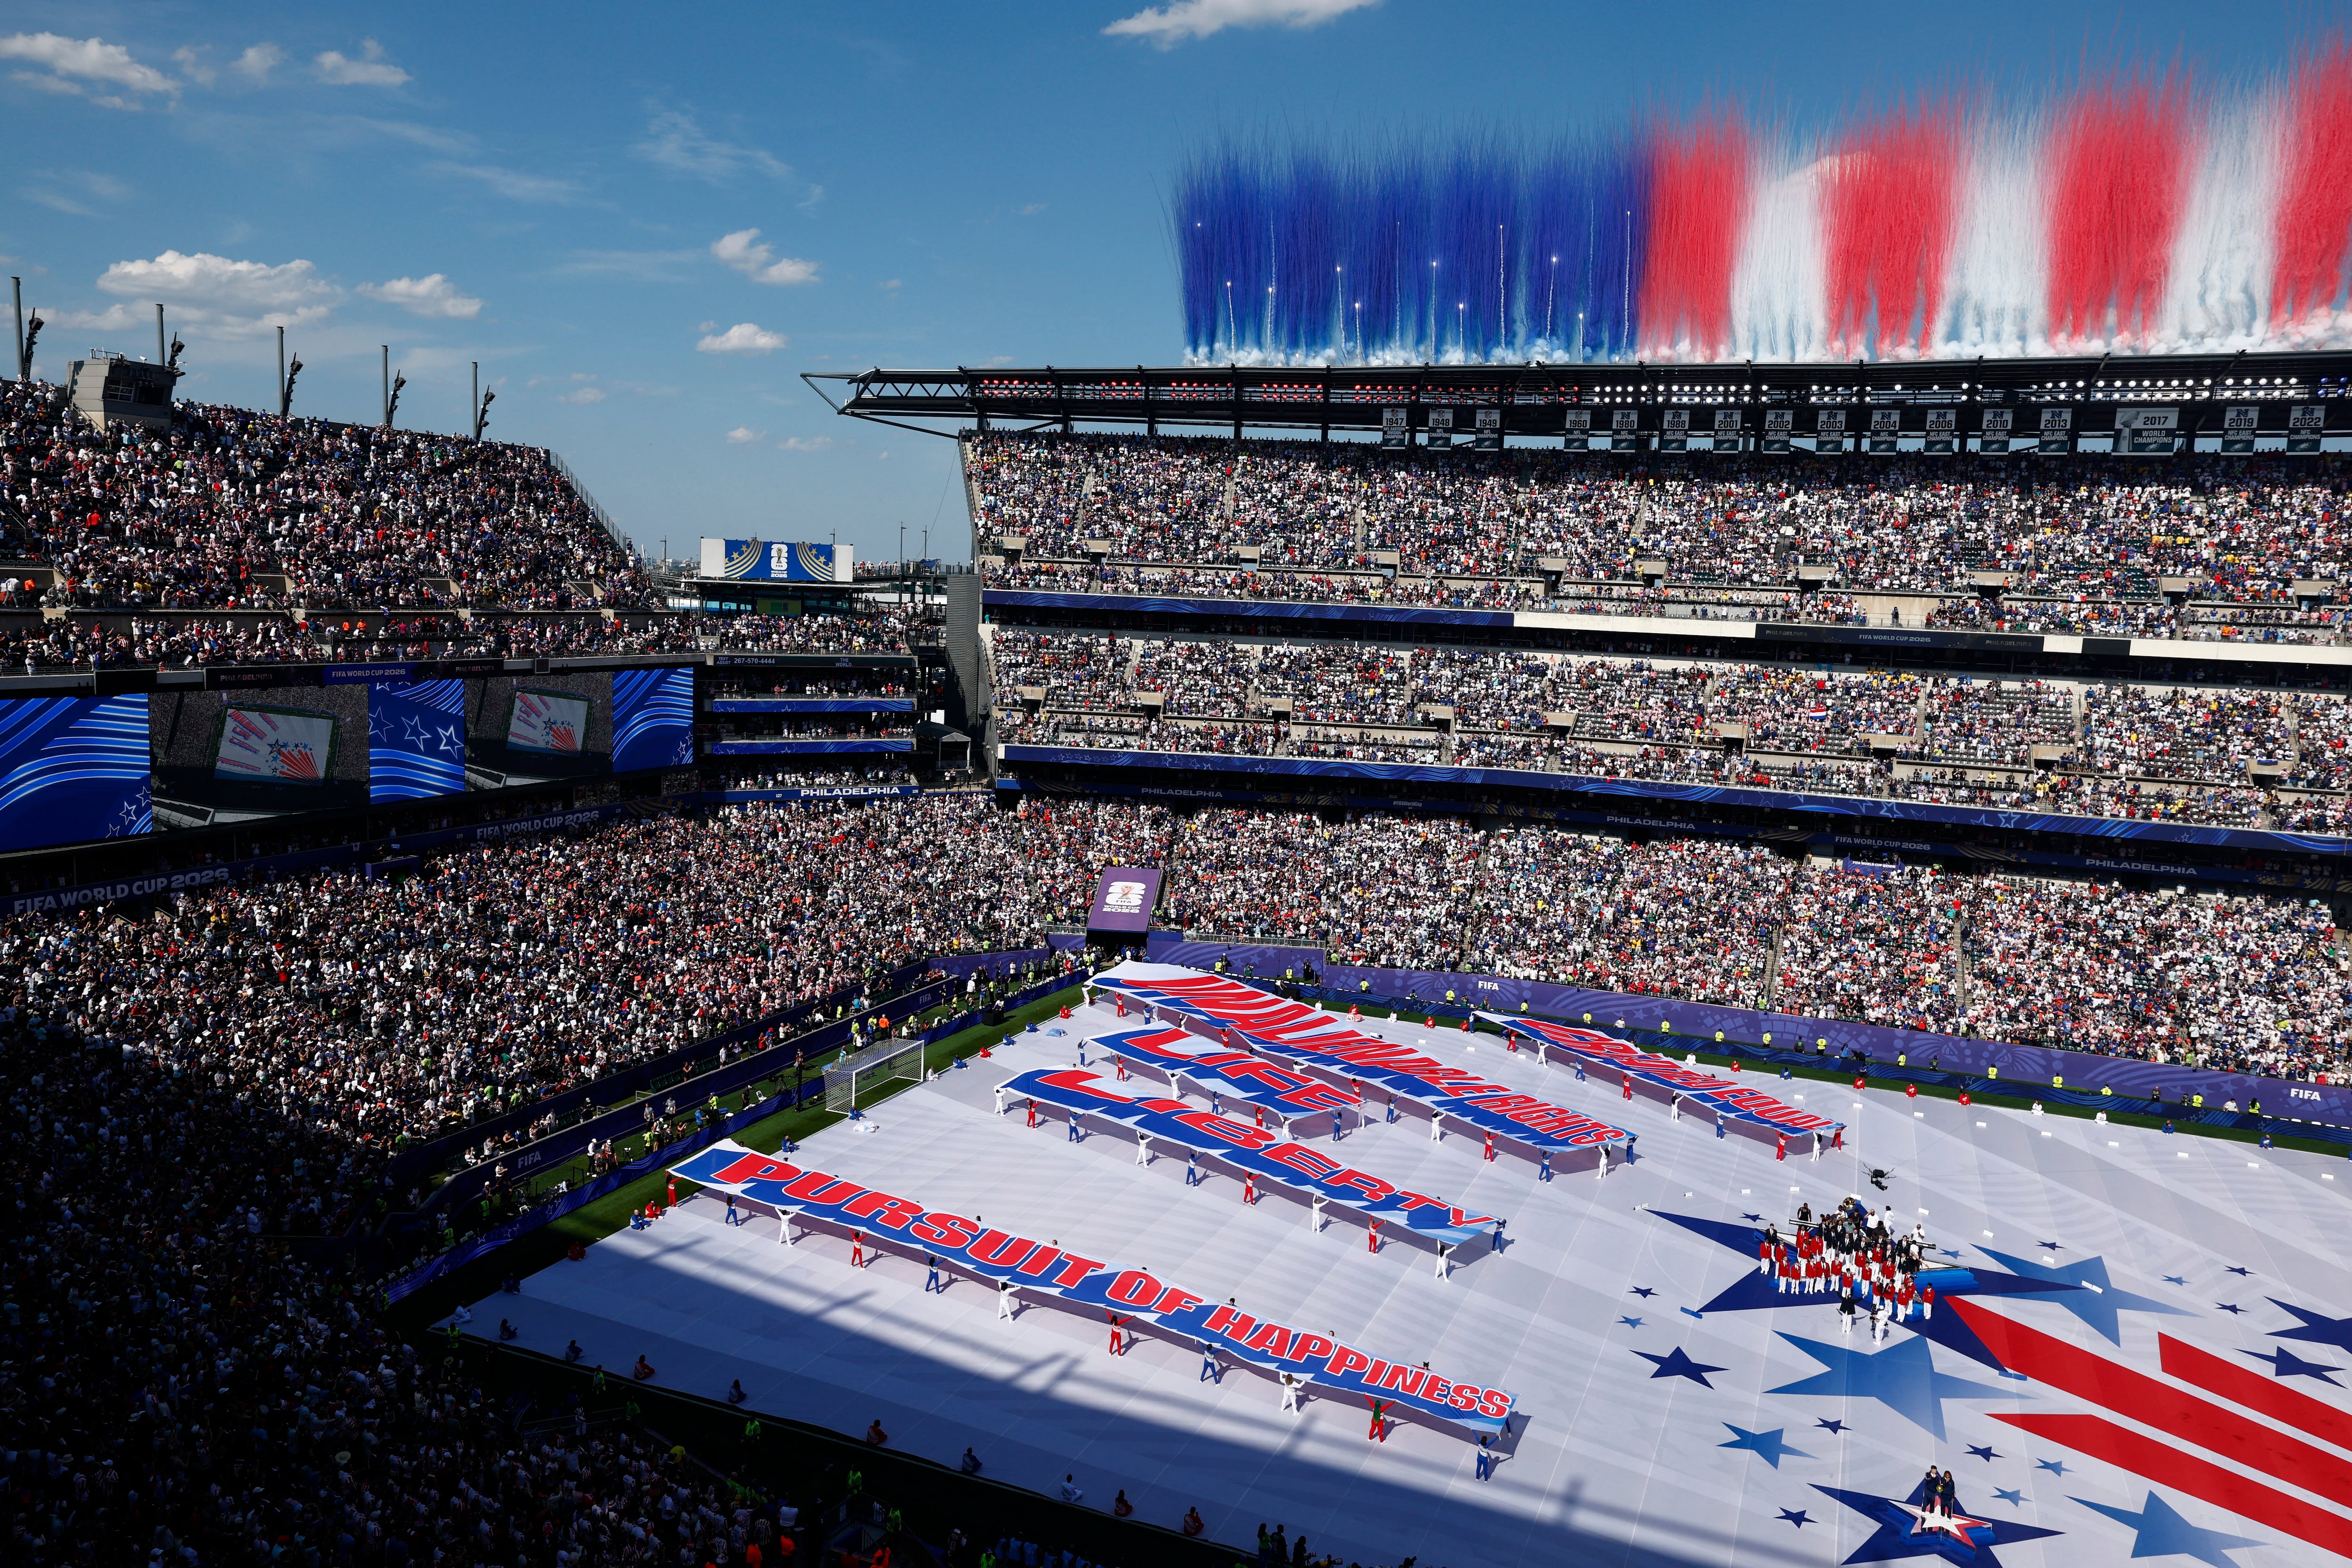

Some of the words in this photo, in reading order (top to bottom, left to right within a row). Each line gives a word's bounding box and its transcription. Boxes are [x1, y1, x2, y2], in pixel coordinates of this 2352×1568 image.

[1820, 421, 1843, 429] 2003
[1874, 421, 1897, 429] 2004
[1929, 420, 1953, 429] 2006
[1986, 420, 2009, 428] 2010
[2044, 419, 2068, 428] 2013
[2143, 416, 2169, 425] 2017
[2229, 418, 2254, 427] 2019
[2292, 417, 2321, 426] 2022
[801, 787, 900, 797] PHILADELPHIA
[1141, 788, 1223, 797] PHILADELPHIA
[477, 827, 501, 840] FIFA
[502, 820, 541, 835] WORLD
[543, 815, 564, 828] CUP
[565, 810, 599, 825] 2026
[1606, 816, 1695, 830] PHILADELPHIA
[1835, 836, 1853, 844] FIFA
[1854, 837, 1882, 846] WORLD
[2086, 859, 2197, 874] PHILADELPHIA
[14, 896, 57, 915] FIFA
[60, 884, 129, 907] WORLD
[132, 878, 167, 896] CUP
[170, 868, 230, 889] 2026
[1478, 980, 1499, 991] FIFA
[919, 993, 931, 1004] FIFA
[1123, 1027, 1365, 1111] LIFE
[2290, 1088, 2321, 1101] FIFA
[1706, 1087, 1836, 1130] EQUAL
[1464, 1093, 1626, 1146] RIGHTS
[1036, 1069, 1500, 1228] LIBERTY
[517, 1151, 541, 1169] FIFA
[709, 1153, 1106, 1289] PURSUIT
[1105, 1268, 1206, 1315] OF
[1202, 1305, 1513, 1419] HAPPINESS
